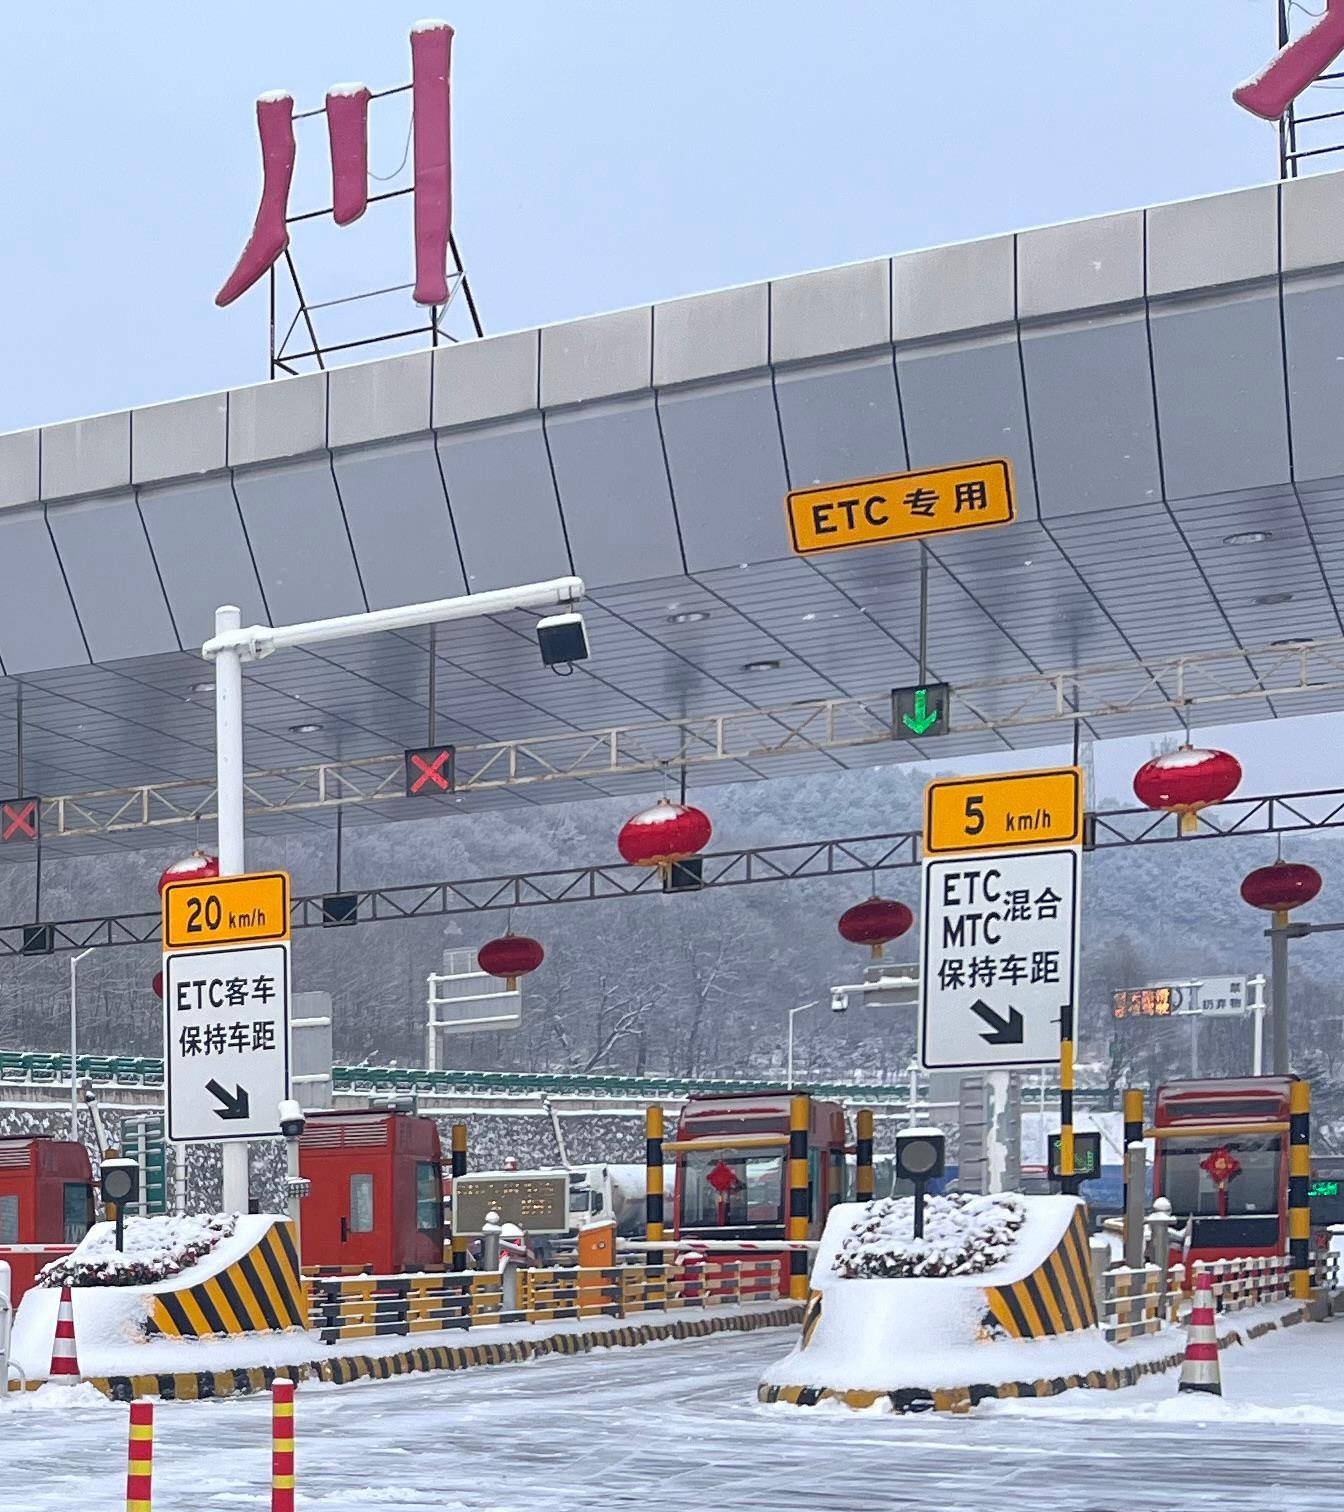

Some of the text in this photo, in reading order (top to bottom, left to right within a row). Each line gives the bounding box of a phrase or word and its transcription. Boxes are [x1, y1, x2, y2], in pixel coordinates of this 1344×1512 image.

[812, 481, 987, 535] ETC 专用
[963, 796, 1052, 835] 5 km/h
[942, 869, 1002, 907] ETC
[1003, 887, 1062, 923] 混合
[185, 895, 266, 933] 20 km/h
[942, 911, 1002, 949] MTC
[938, 950, 1060, 991] 保持车距
[179, 1020, 276, 1058] 保持车距
